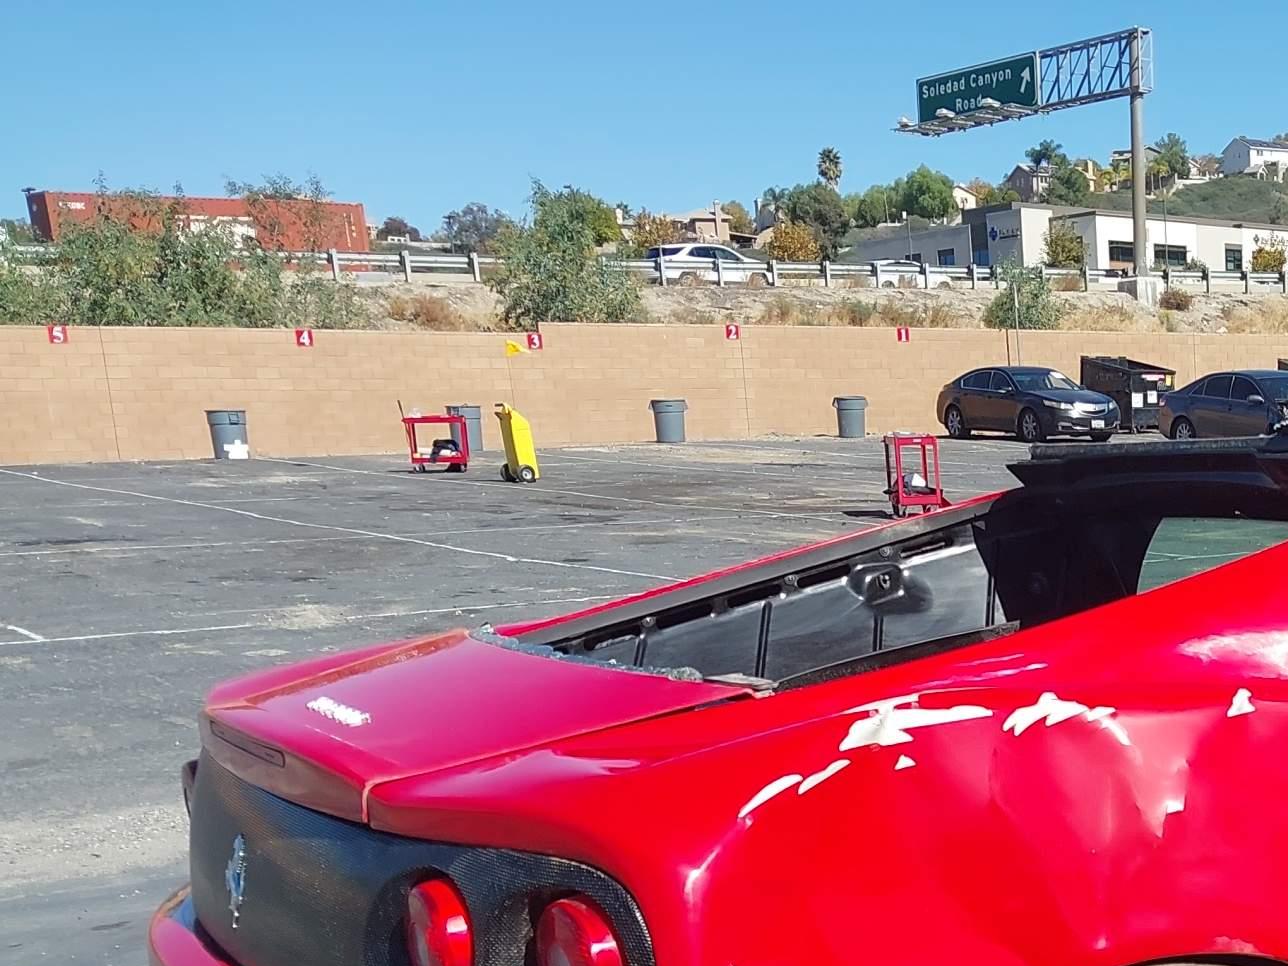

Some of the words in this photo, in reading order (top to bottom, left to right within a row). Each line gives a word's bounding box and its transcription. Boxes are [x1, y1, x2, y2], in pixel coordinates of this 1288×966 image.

[922, 77, 965, 98] Soledad
[969, 68, 1012, 89] Canyon
[955, 94, 983, 112] Road
[53, 326, 63, 343] 5
[300, 330, 310, 346] 4
[728, 325, 737, 339] 2
[531, 334, 540, 348] 3
